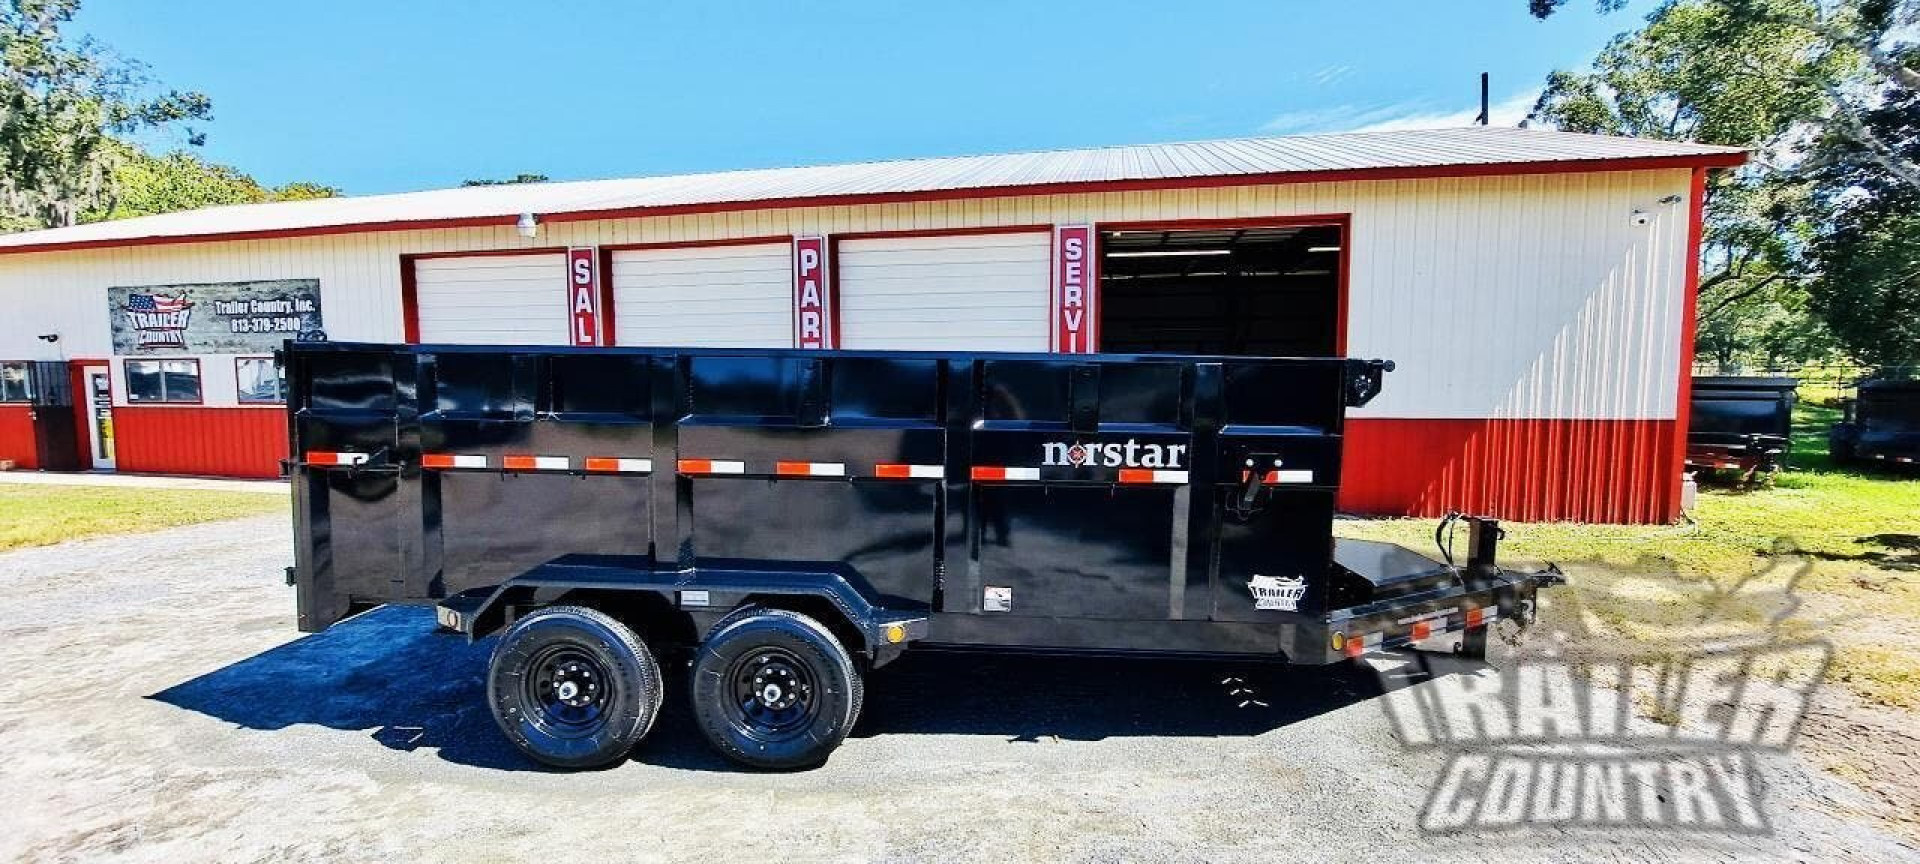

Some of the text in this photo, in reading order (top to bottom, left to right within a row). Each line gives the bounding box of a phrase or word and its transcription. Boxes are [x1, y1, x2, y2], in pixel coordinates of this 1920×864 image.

[215, 298, 316, 315] Trailer Country, Inc.
[127, 309, 190, 329] TRAILER
[231, 317, 301, 333] 813-379-2500
[139, 330, 184, 344] COUNTRY
[1249, 586, 1305, 600] TRAILER
